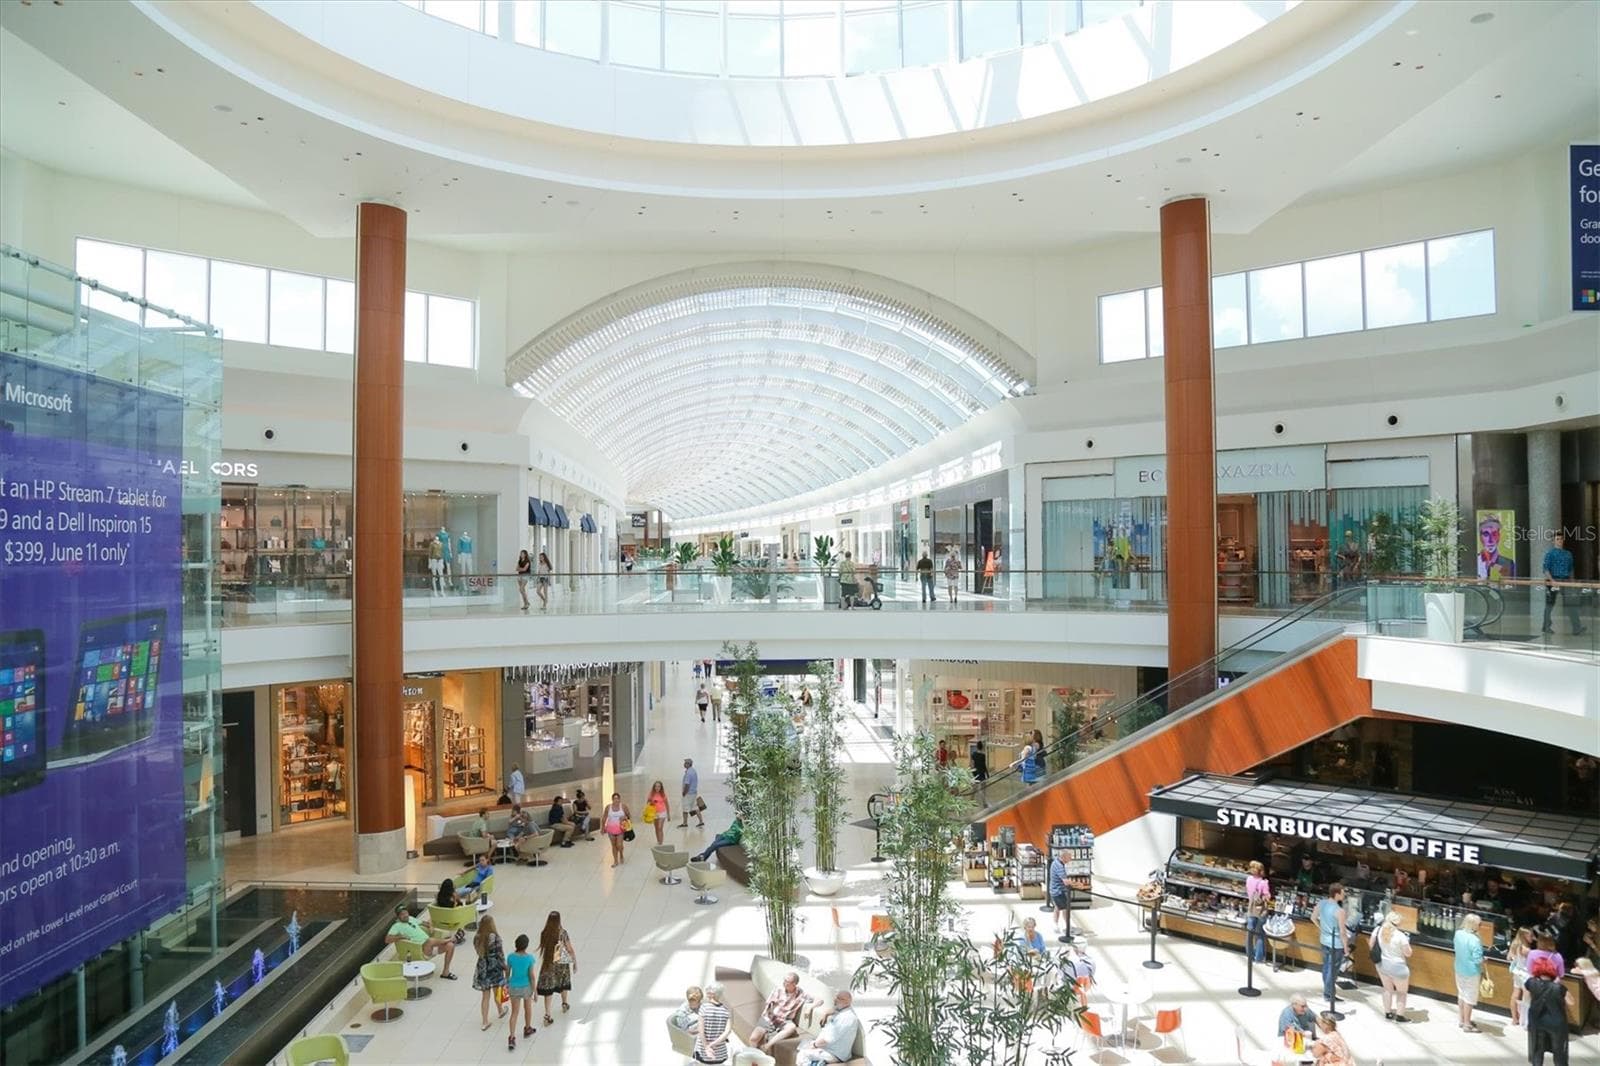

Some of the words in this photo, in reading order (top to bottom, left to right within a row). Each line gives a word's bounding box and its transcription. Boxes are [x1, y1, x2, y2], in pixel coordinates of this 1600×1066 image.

[1579, 184, 1600, 203] fo
[5, 382, 73, 413] Microsoft
[10, 482, 29, 500] an
[34, 479, 55, 499] HP
[58, 481, 104, 503] Stream
[106, 486, 115, 504] 7
[117, 487, 149, 507] tablet
[152, 489, 167, 507] for
[12, 510, 42, 530] and
[45, 516, 54, 531] a
[58, 511, 85, 532] Dell
[88, 513, 137, 538] Inspiron
[139, 516, 152, 533] 15
[5, 539, 46, 565] $399,
[50, 542, 83, 562] June
[86, 542, 97, 561] 11
[468, 577, 494, 588] SALE
[1217, 808, 1365, 846] STARBUCKS
[1371, 832, 1480, 864] COFFEE
[0, 853, 19, 877] nd
[22, 837, 75, 869] opening,
[20, 870, 53, 896] open
[55, 862, 67, 880] at
[69, 847, 97, 872] 10:30
[99, 842, 121, 860] a.m.
[0, 940, 12, 957] ed
[13, 936, 26, 949] on
[26, 929, 41, 943] the
[41, 916, 64, 935] Lower
[64, 904, 84, 922] Level
[84, 899, 99, 913] near
[99, 886, 120, 905] Grand
[120, 879, 138, 894] Court
